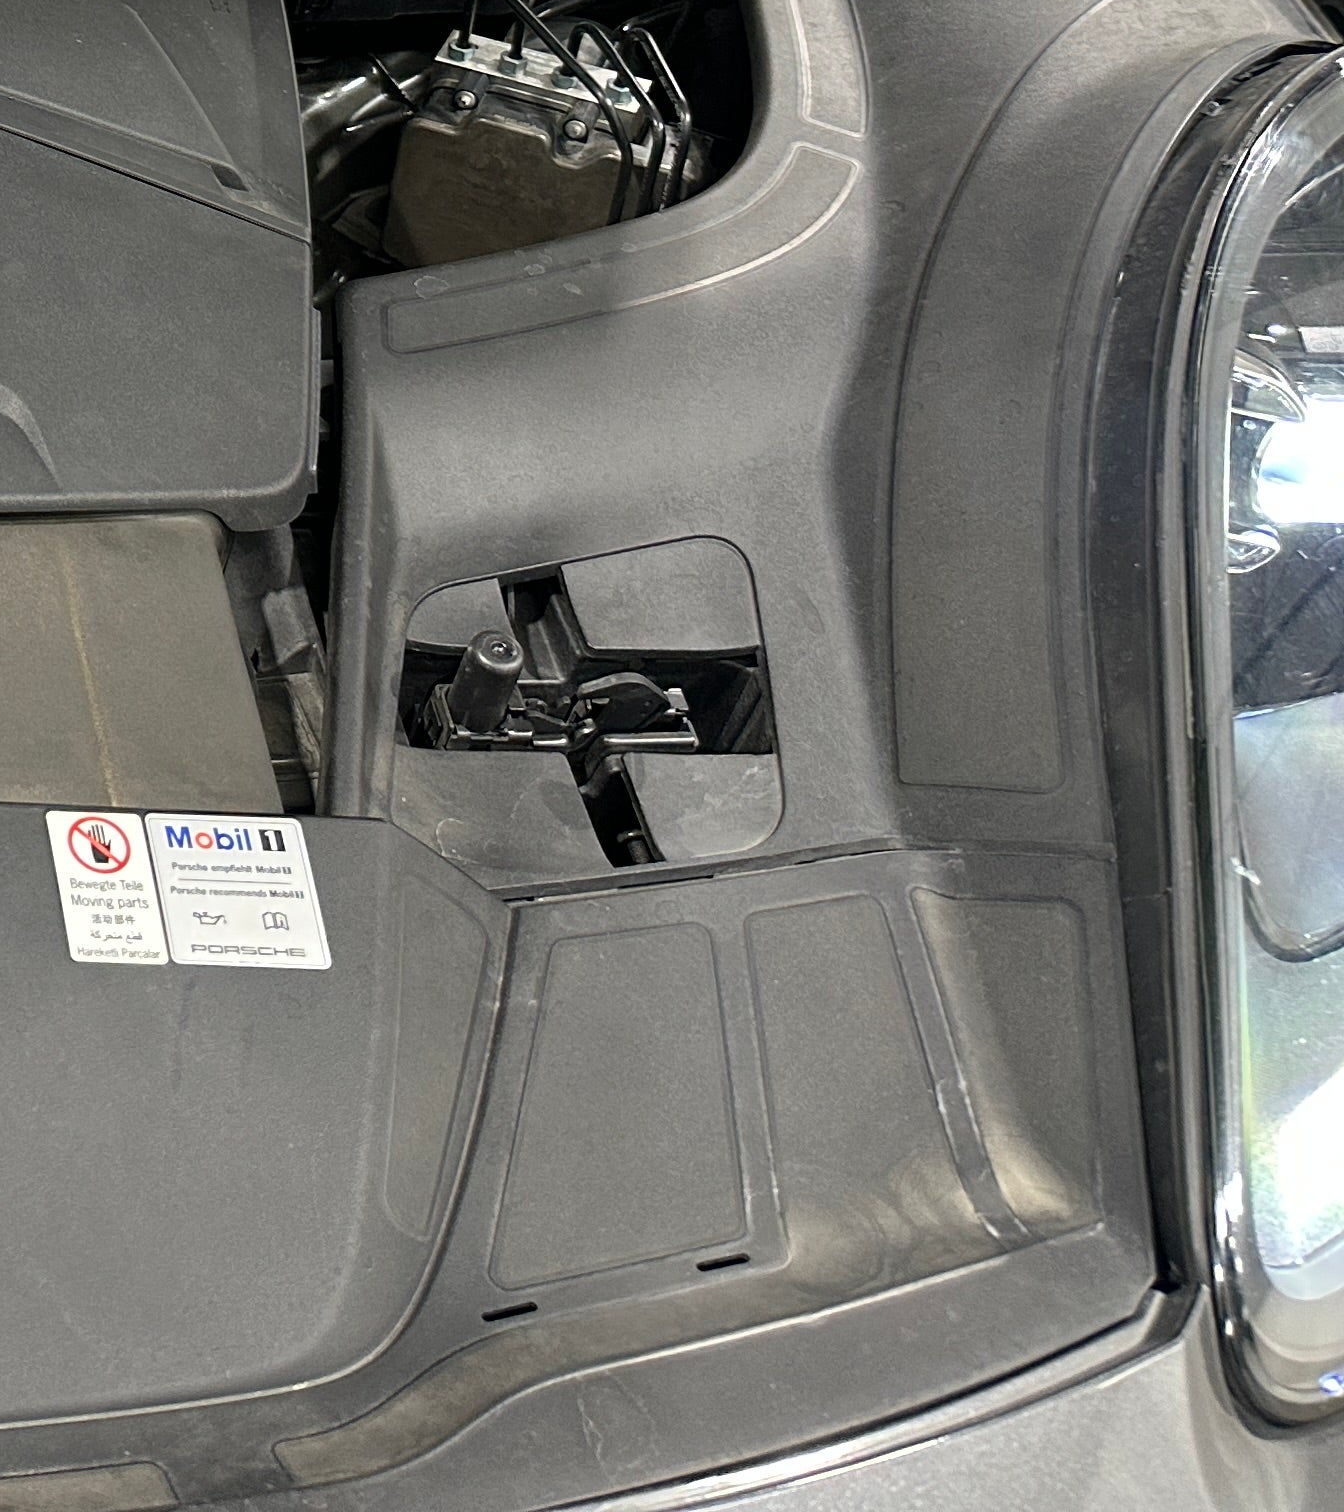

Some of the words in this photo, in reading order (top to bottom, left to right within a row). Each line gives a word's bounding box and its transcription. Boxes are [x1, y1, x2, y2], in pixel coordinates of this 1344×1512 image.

[165, 825, 253, 851] Mobil
[172, 862, 208, 872] Porsche
[69, 878, 117, 892] Bewegte
[119, 879, 144, 892] Teile
[170, 886, 207, 896] Porsche
[209, 888, 268, 898] recommends
[70, 894, 115, 910] Moving
[117, 897, 150, 910] parts
[190, 943, 306, 957] PORSCHE
